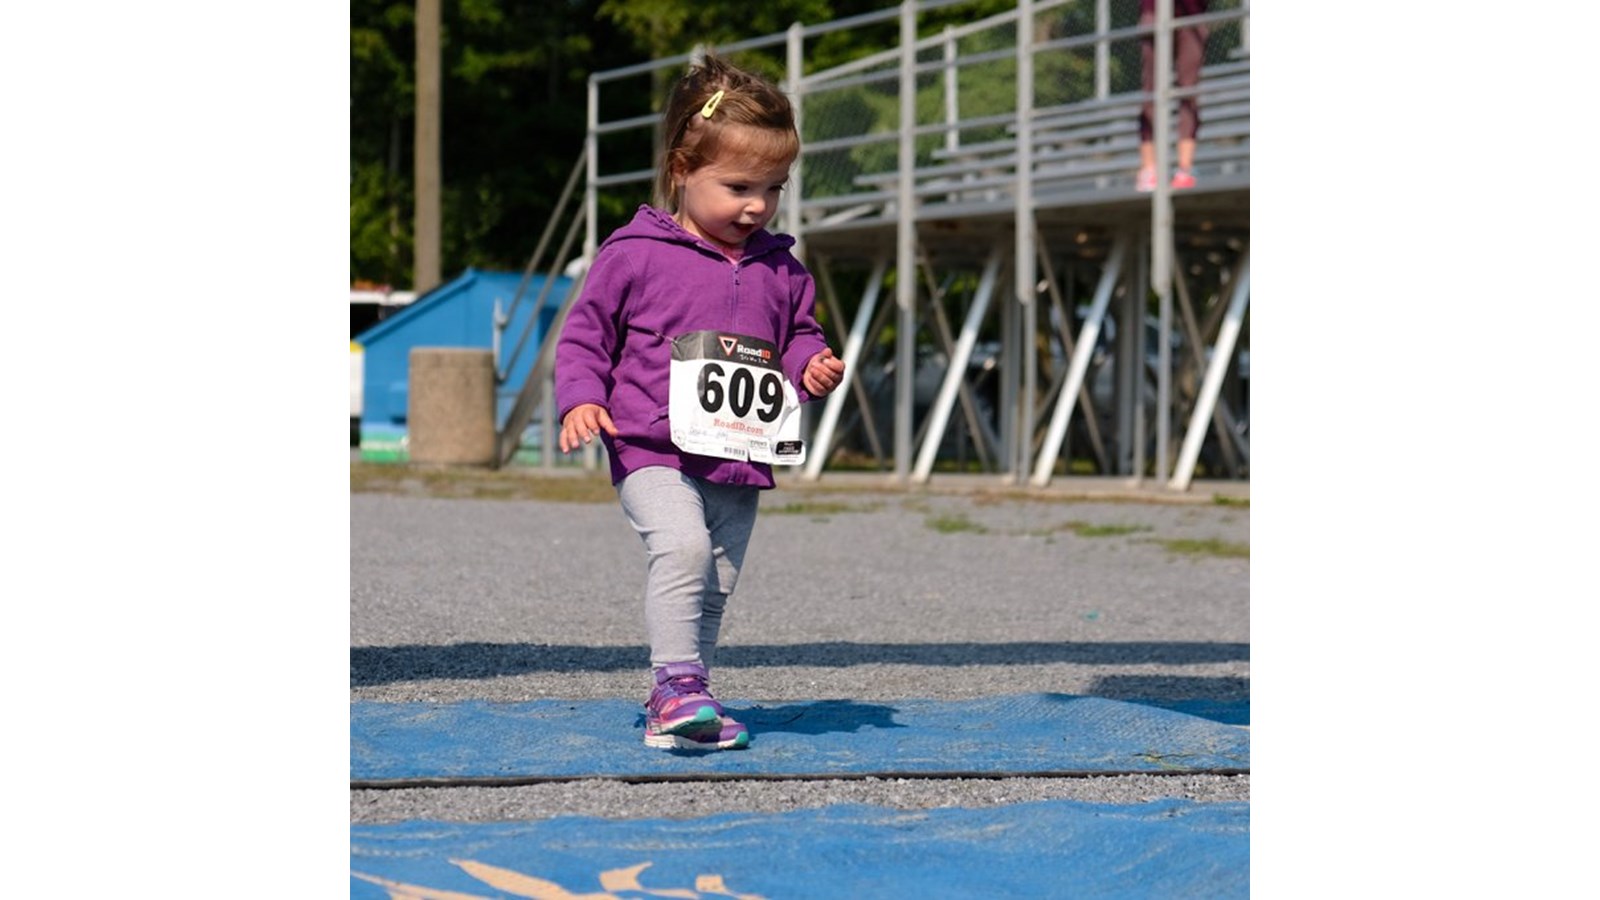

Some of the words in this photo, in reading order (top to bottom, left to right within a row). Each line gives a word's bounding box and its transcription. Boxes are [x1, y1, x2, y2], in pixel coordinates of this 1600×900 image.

[736, 344, 771, 359] RoadID
[697, 362, 784, 423] 609
[713, 418, 764, 436] RoadID.com
